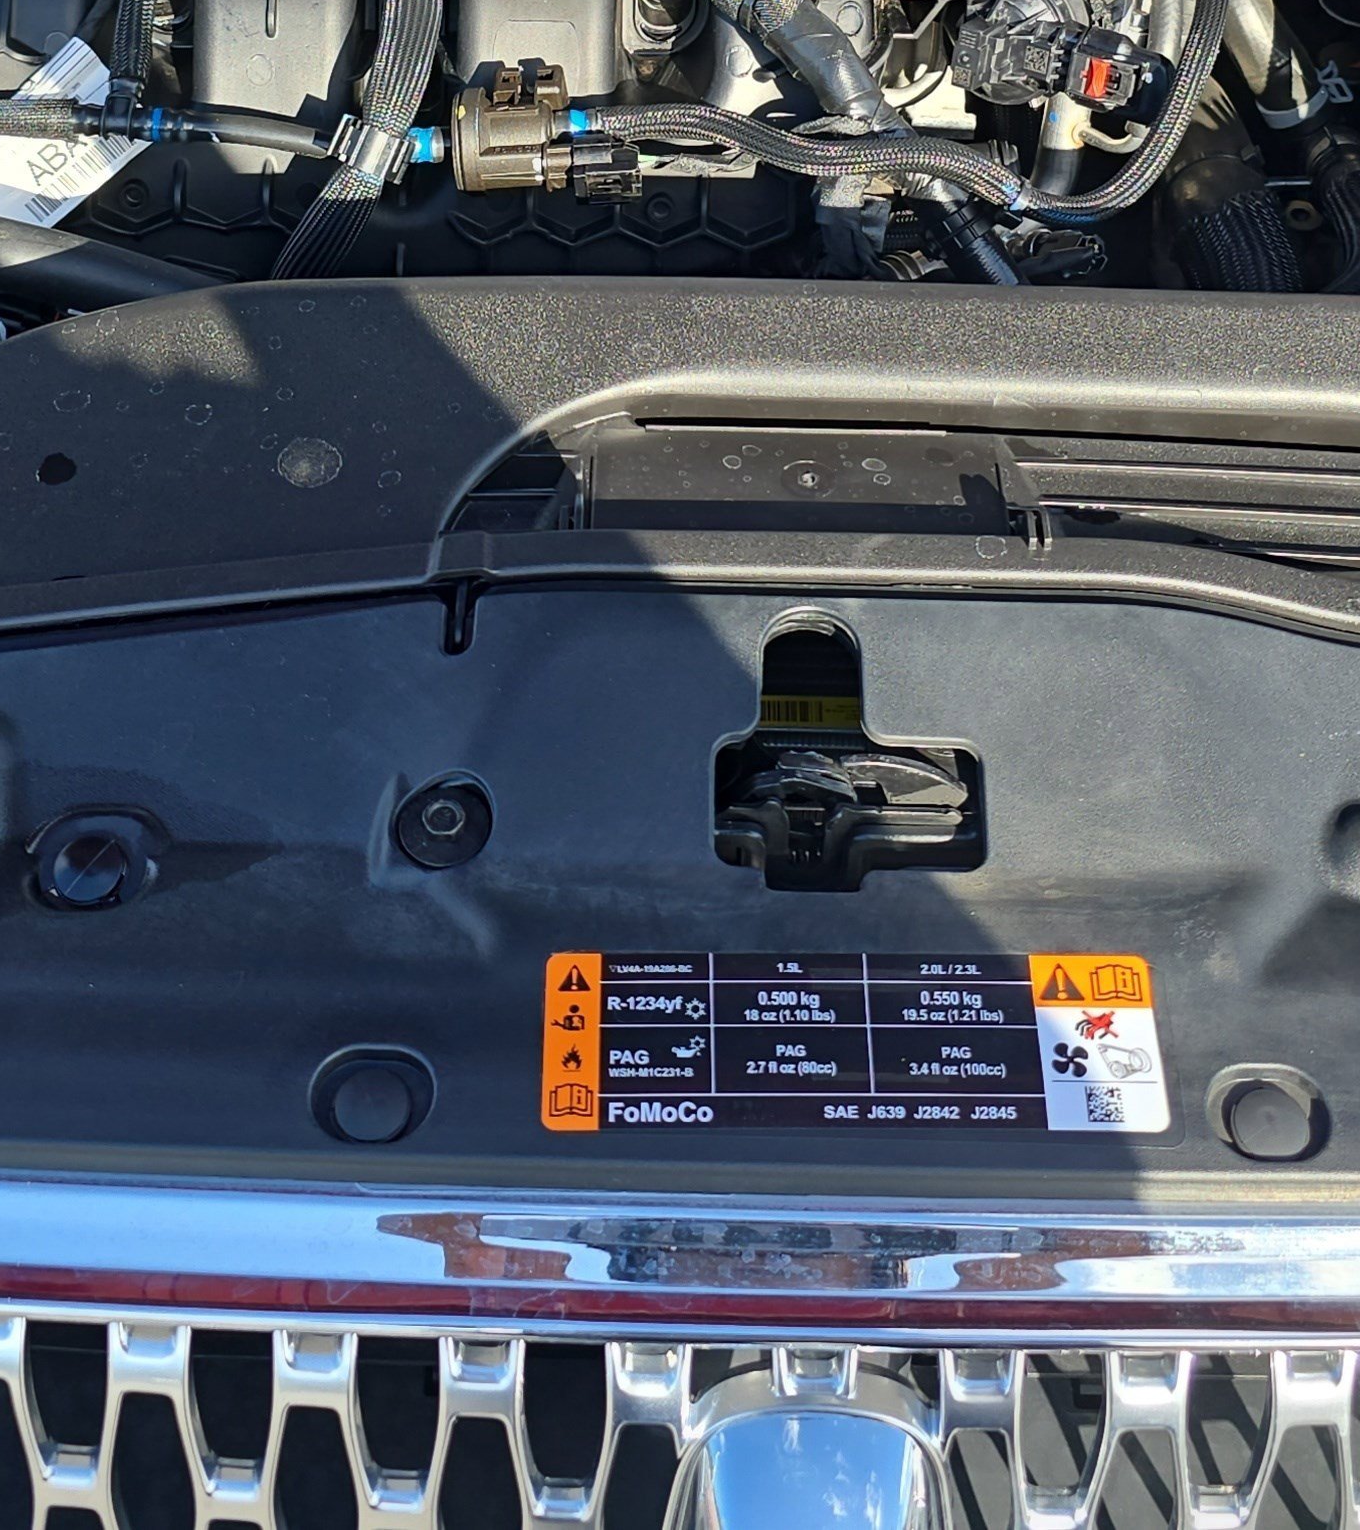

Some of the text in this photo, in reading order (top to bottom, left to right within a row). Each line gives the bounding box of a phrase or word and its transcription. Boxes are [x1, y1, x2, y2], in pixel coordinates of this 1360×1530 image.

[776, 963, 803, 973] 1.5L
[920, 964, 947, 975] 2.0L
[954, 964, 982, 975] 2.3L
[607, 996, 683, 1013] R-1234yf
[758, 991, 820, 1008] 0.500 kg
[920, 991, 982, 1008] 0.550 kg
[744, 1009, 836, 1023] 18 oz (1.10 lbs)
[902, 1009, 1004, 1024] 19.5 oz (1.21 lbs)
[609, 1050, 650, 1064] PAG
[776, 1045, 807, 1057] PAG
[941, 1047, 972, 1058] PAG
[746, 1061, 837, 1076] 2.7 fl oz (80cc)
[909, 1062, 1007, 1078] 3.4 fl oz (100cc)
[608, 1101, 714, 1123] FoMoCo
[824, 1105, 1017, 1120] SAE J639 J2842 J2845
